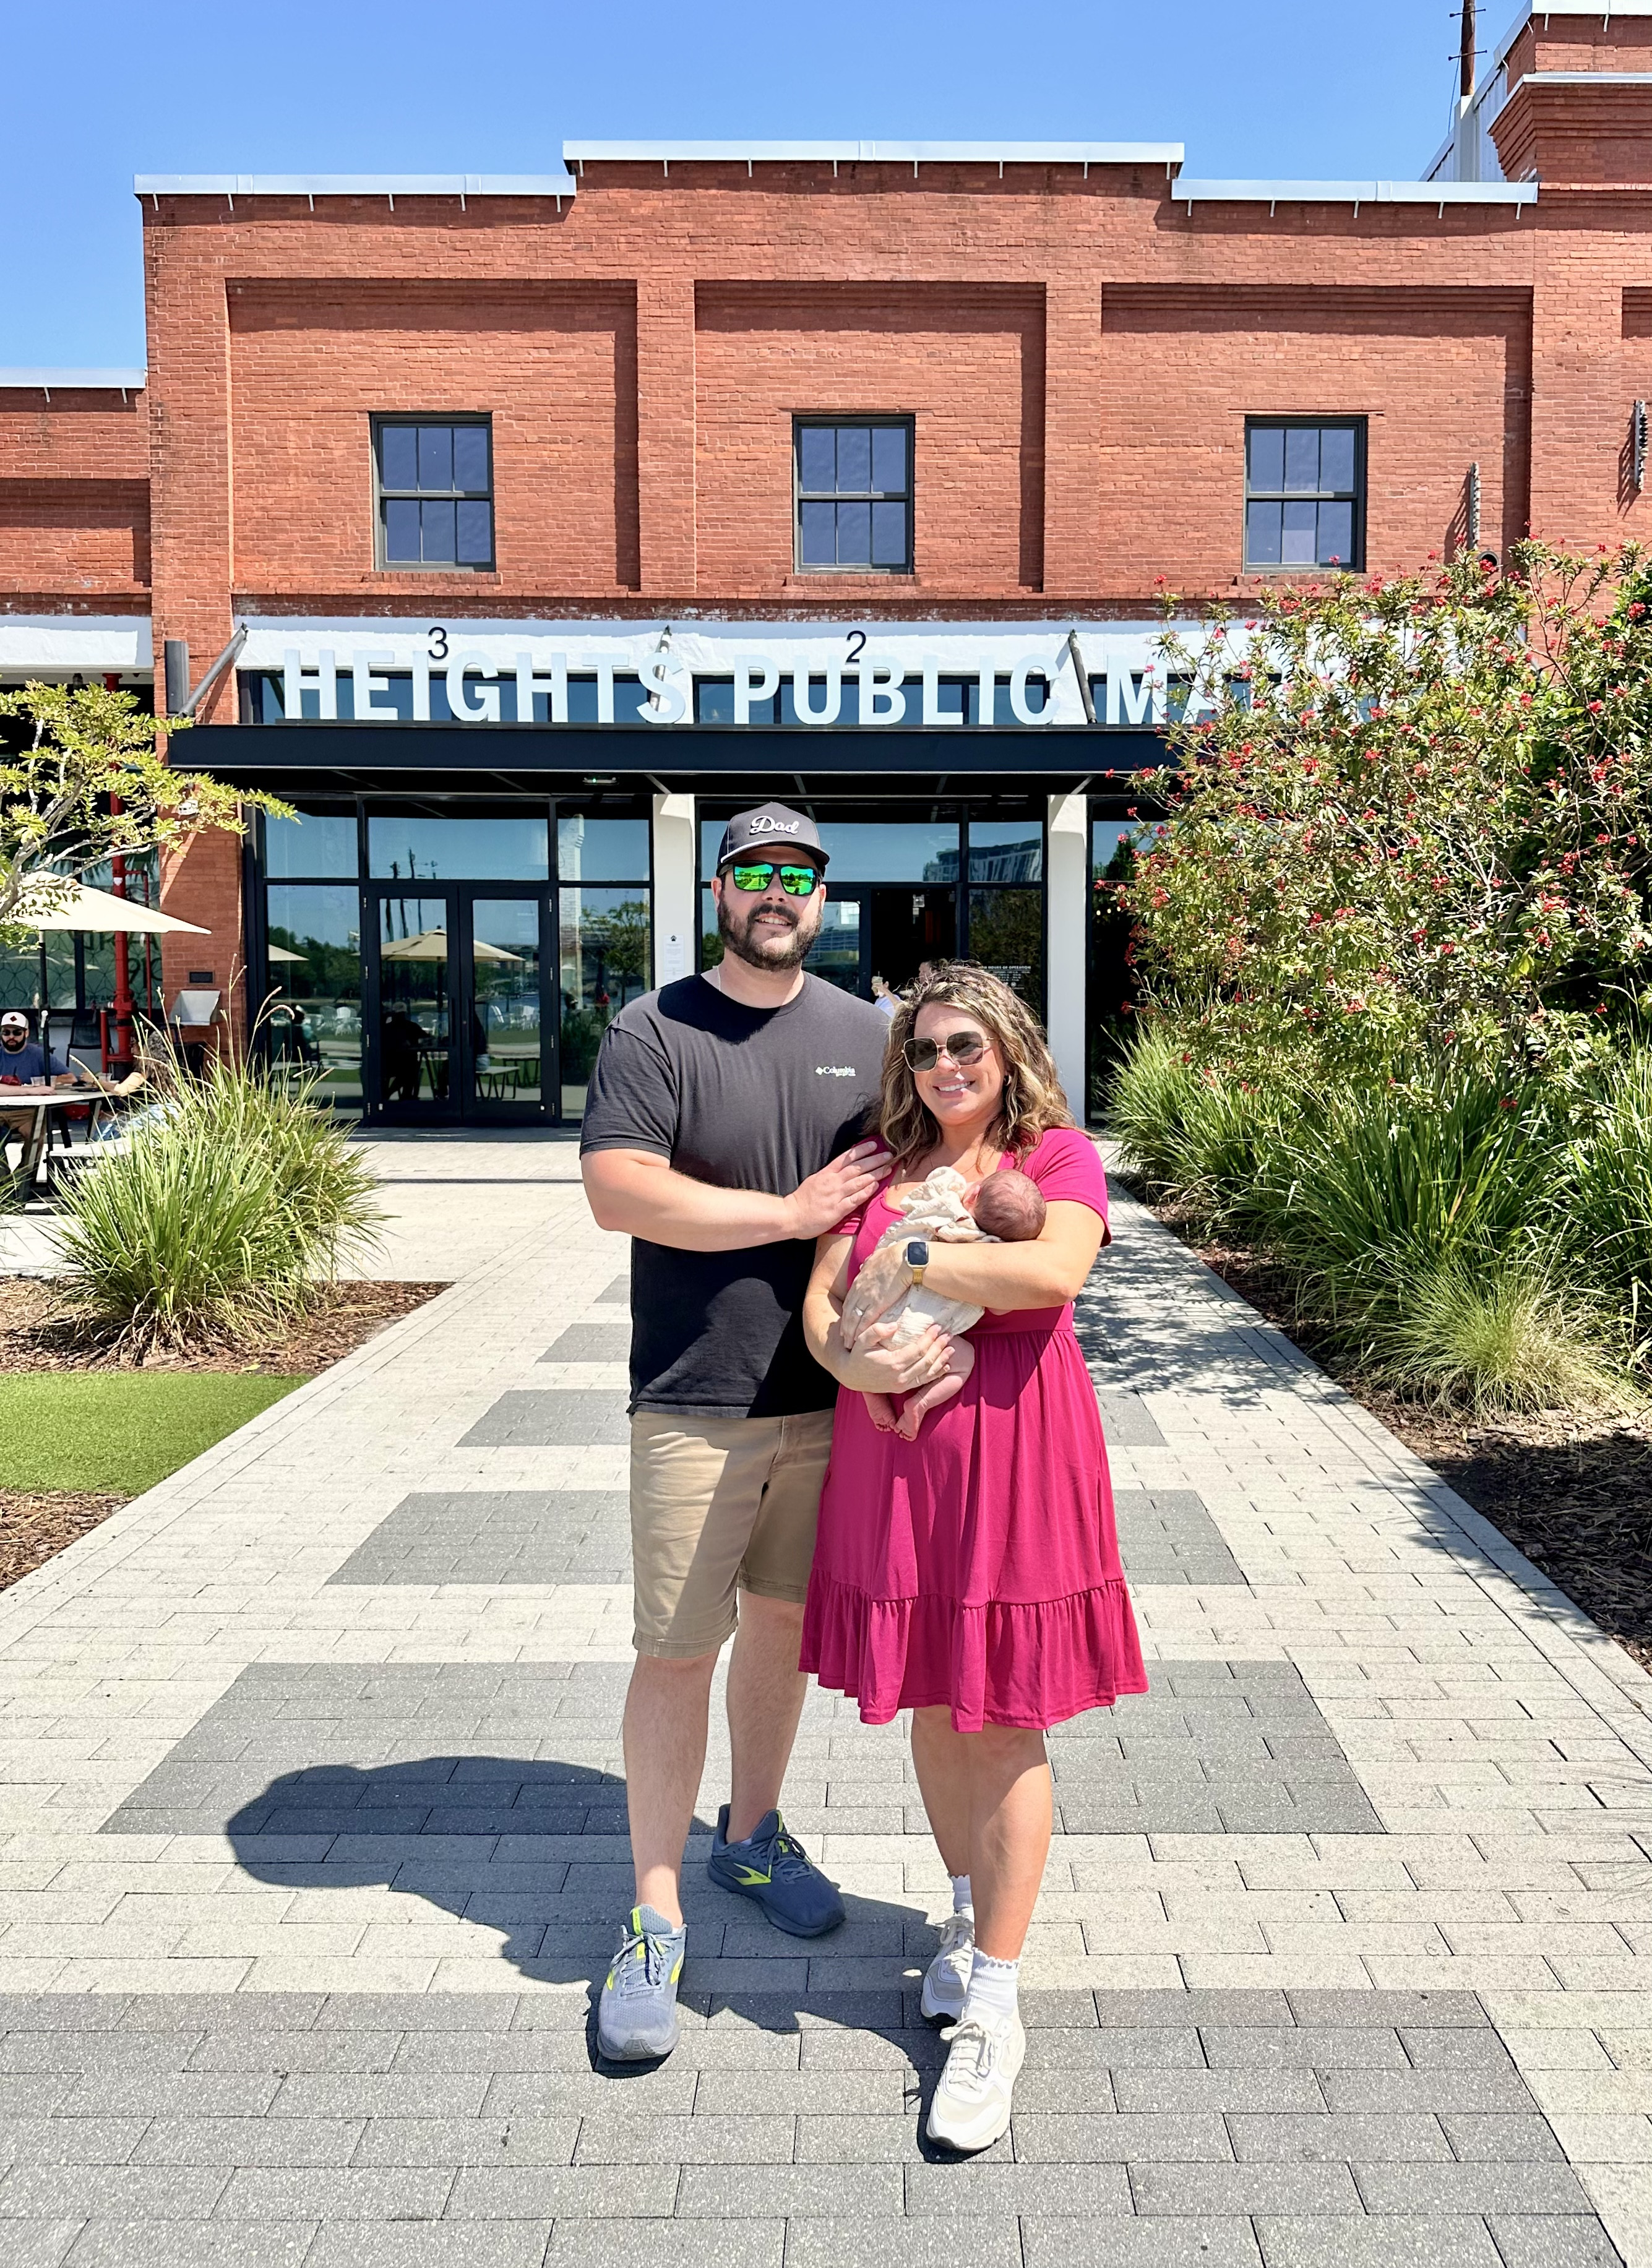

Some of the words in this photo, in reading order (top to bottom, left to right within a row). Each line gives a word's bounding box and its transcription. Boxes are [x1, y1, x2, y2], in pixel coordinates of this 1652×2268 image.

[428, 626, 449, 660] 3
[845, 630, 867, 664] 2
[283, 649, 686, 724] HEIGHTS
[734, 653, 1060, 726] PUBLIC
[749, 815, 800, 835] Dad
[823, 1066, 856, 1074] Columbia
